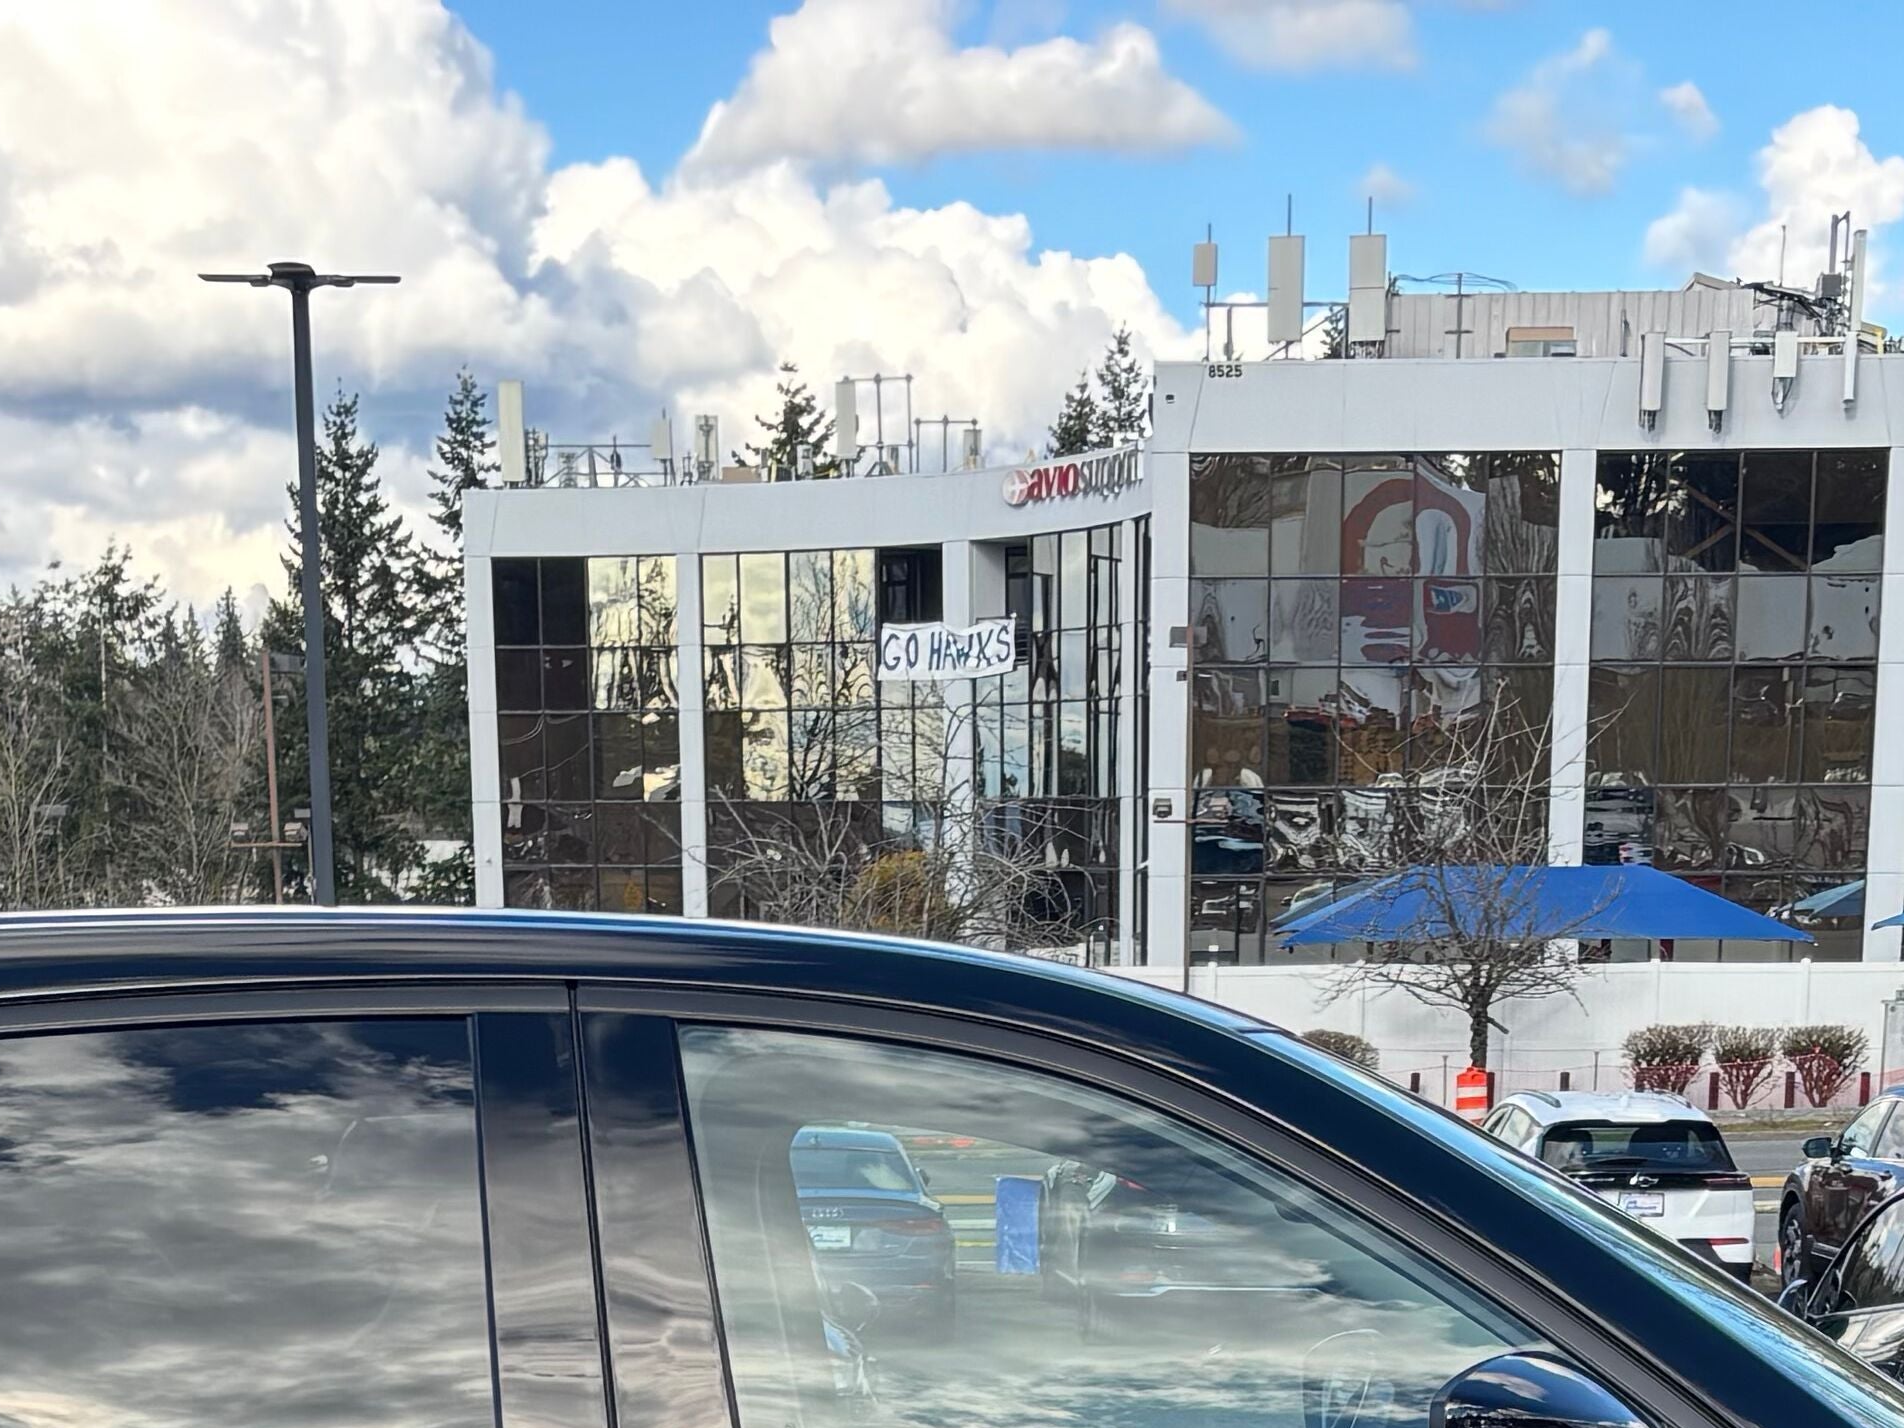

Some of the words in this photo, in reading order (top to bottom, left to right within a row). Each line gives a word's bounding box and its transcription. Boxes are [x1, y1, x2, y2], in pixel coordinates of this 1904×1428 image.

[1208, 364, 1243, 379] 8525
[884, 633, 919, 671] GO
[928, 625, 1011, 671] HAWKS
